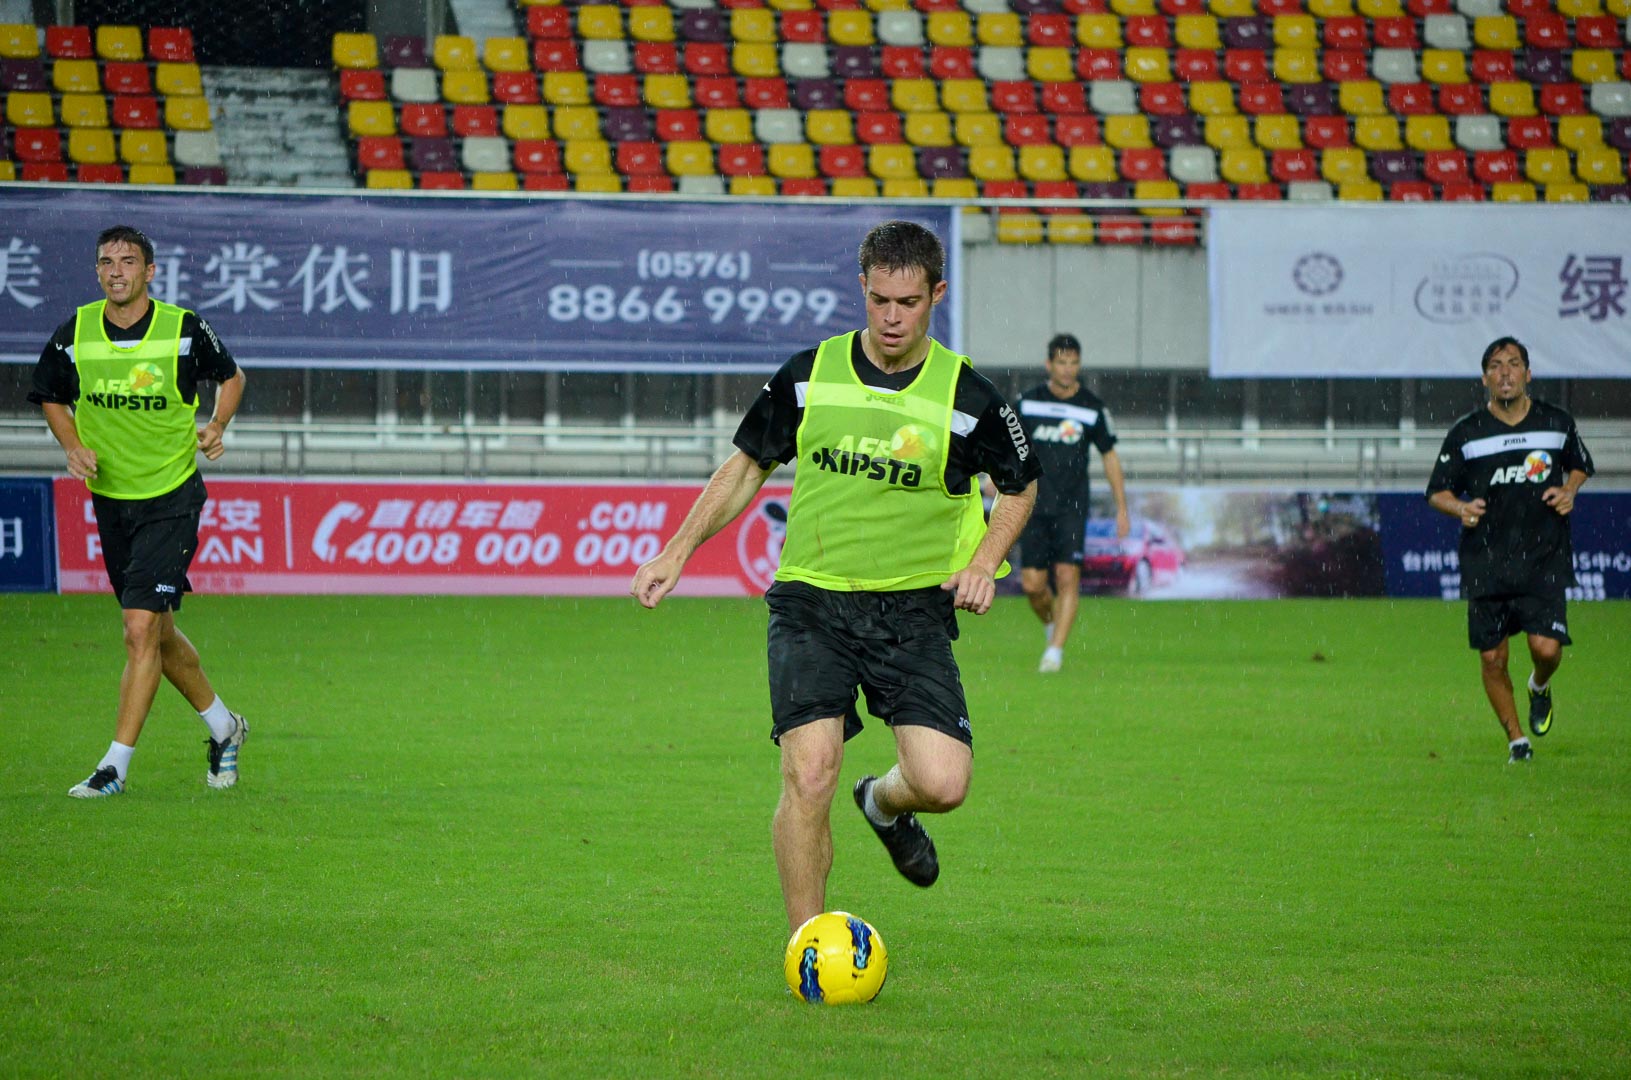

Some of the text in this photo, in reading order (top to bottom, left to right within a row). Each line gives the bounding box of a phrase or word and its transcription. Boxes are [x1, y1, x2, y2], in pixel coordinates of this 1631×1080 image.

[637, 250, 751, 280] (0576)
[547, 284, 838, 325] 8866 9999
[1558, 253, 1629, 322] 绿
[577, 501, 668, 531] .COM
[345, 531, 662, 567] 4008 000 000
